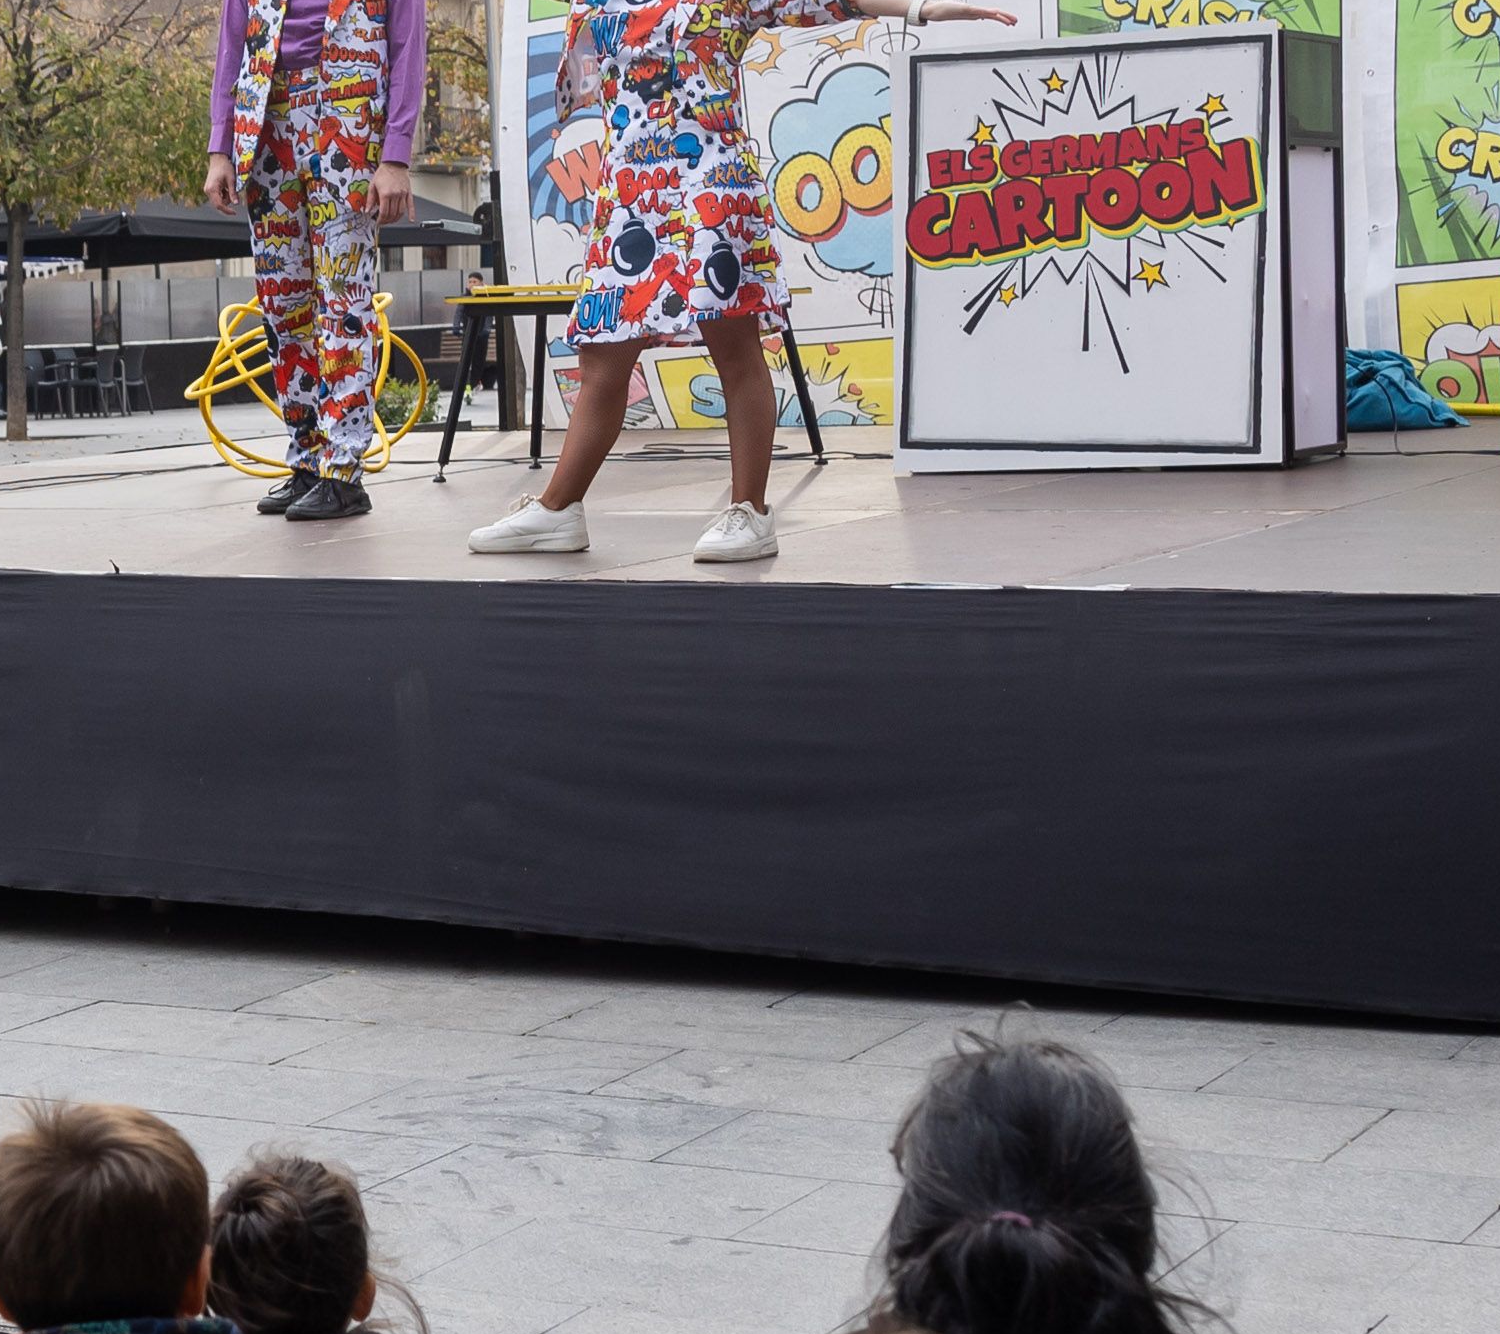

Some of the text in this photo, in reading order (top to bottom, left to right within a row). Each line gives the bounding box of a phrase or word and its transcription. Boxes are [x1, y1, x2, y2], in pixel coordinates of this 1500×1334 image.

[625, 139, 678, 163] CRACK
[926, 118, 1209, 189] ELS GERMANS
[905, 138, 1258, 259] CARTOON
